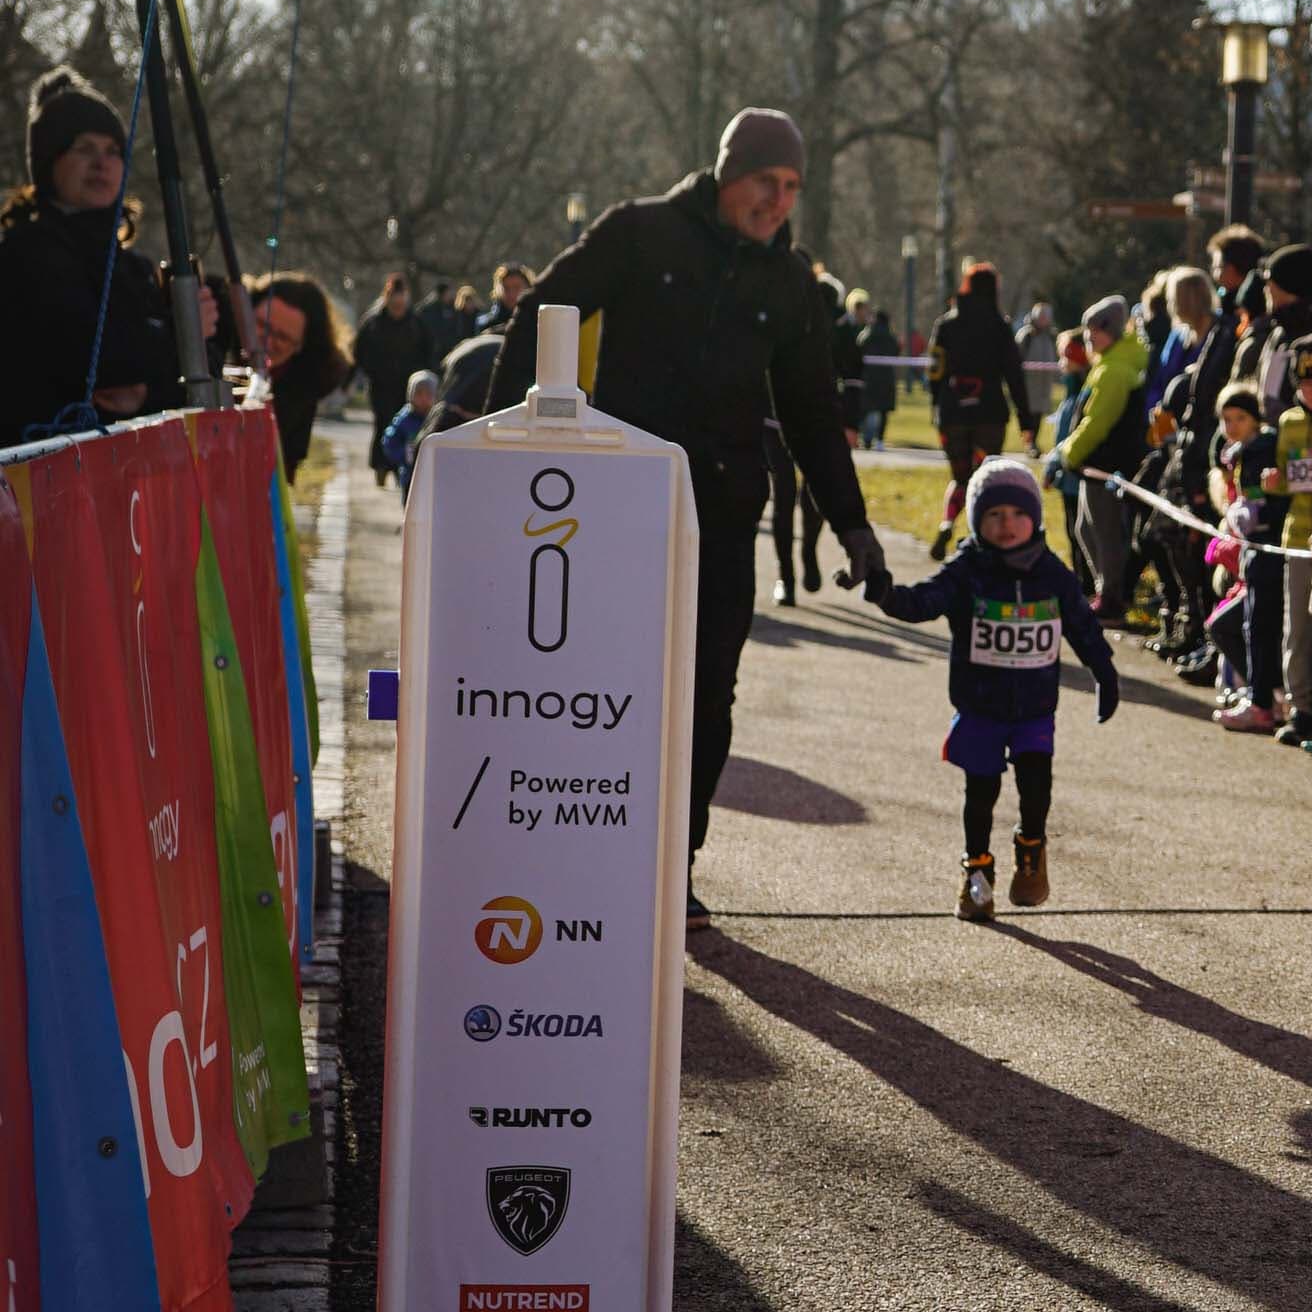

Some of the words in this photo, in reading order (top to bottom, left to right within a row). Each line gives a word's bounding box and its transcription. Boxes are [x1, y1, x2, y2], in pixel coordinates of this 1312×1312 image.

[975, 622, 1054, 654] 3050
[455, 676, 633, 730] innogy
[509, 769, 631, 796] Powered
[508, 800, 543, 831] by
[553, 802, 628, 827] MVM
[555, 919, 603, 942] NN
[506, 1008, 604, 1038] ŠKODA
[492, 1107, 593, 1128] RUNTO
[494, 1174, 563, 1183] PEUGEOT
[466, 1291, 584, 1312] NUTREND
